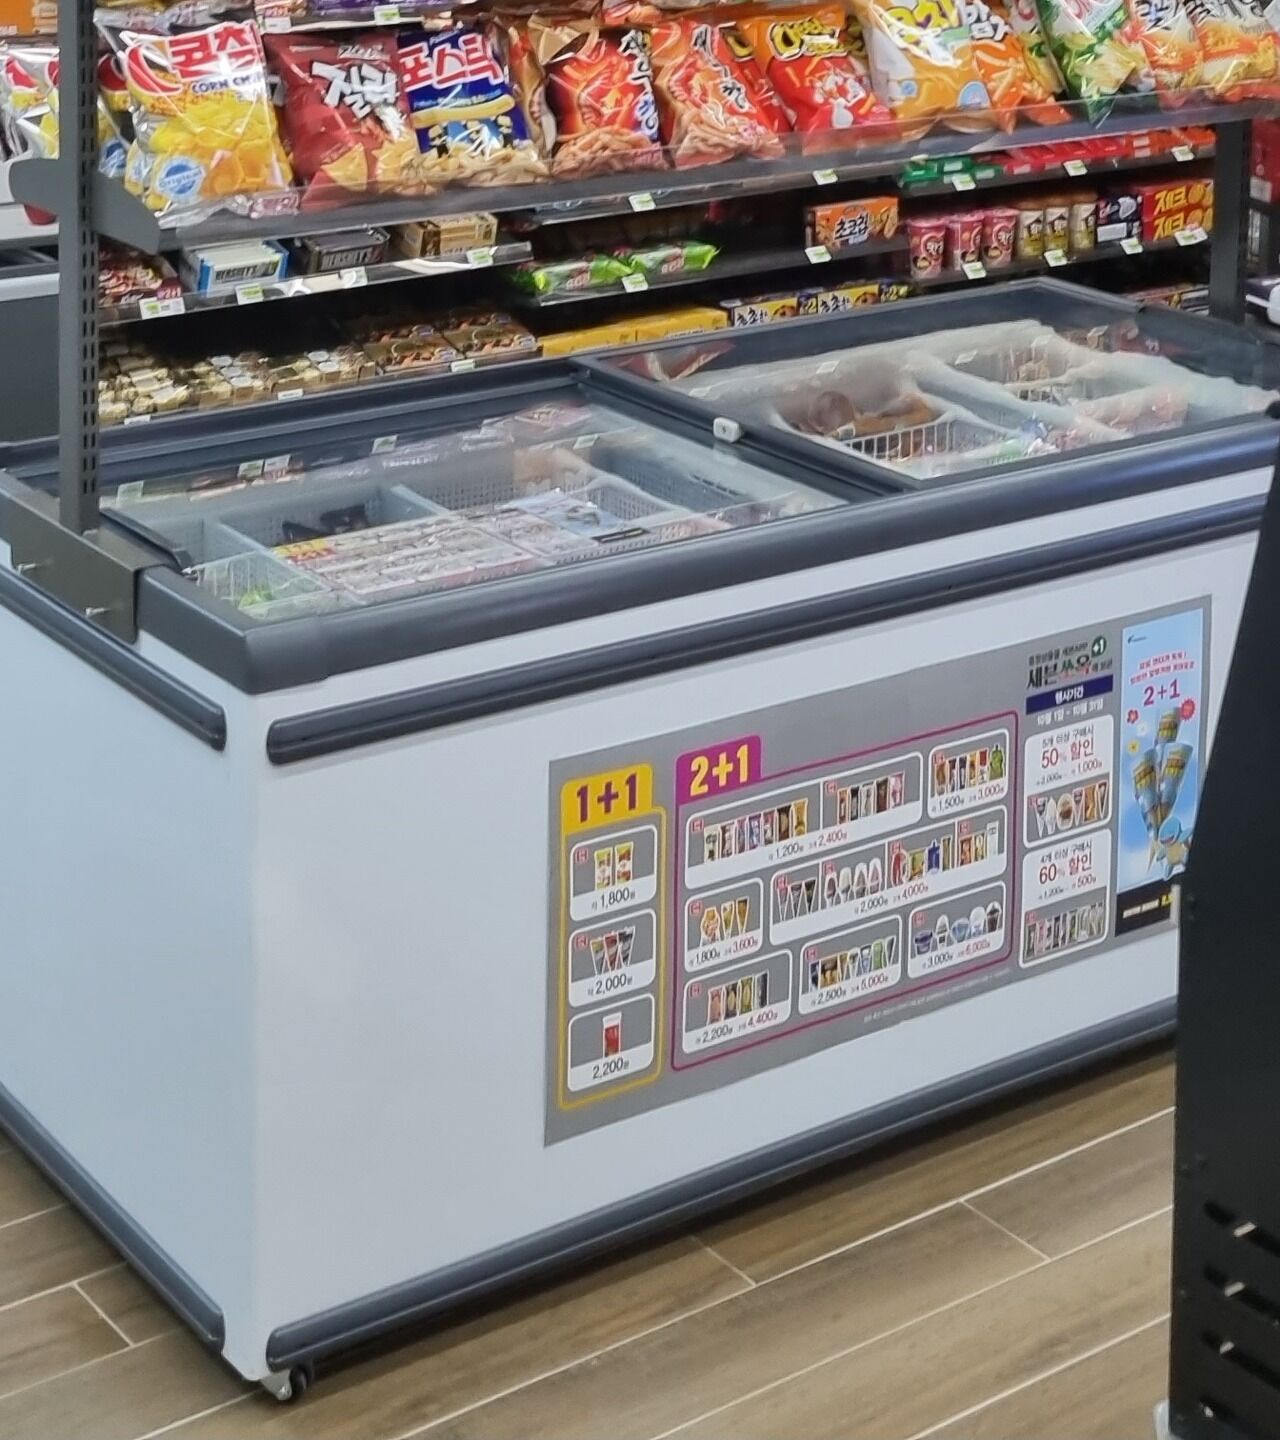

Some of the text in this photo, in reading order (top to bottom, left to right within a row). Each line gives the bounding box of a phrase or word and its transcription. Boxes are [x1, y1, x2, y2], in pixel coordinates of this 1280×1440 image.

[398, 33, 506, 94] 포스틱
[191, 79, 230, 95] CORN
[214, 263, 259, 282] HERSHEY'S
[1142, 677, 1181, 707] 2+1
[1070, 737, 1094, 762] 할인
[690, 743, 749, 797] 2+1
[576, 771, 638, 824] 1+1
